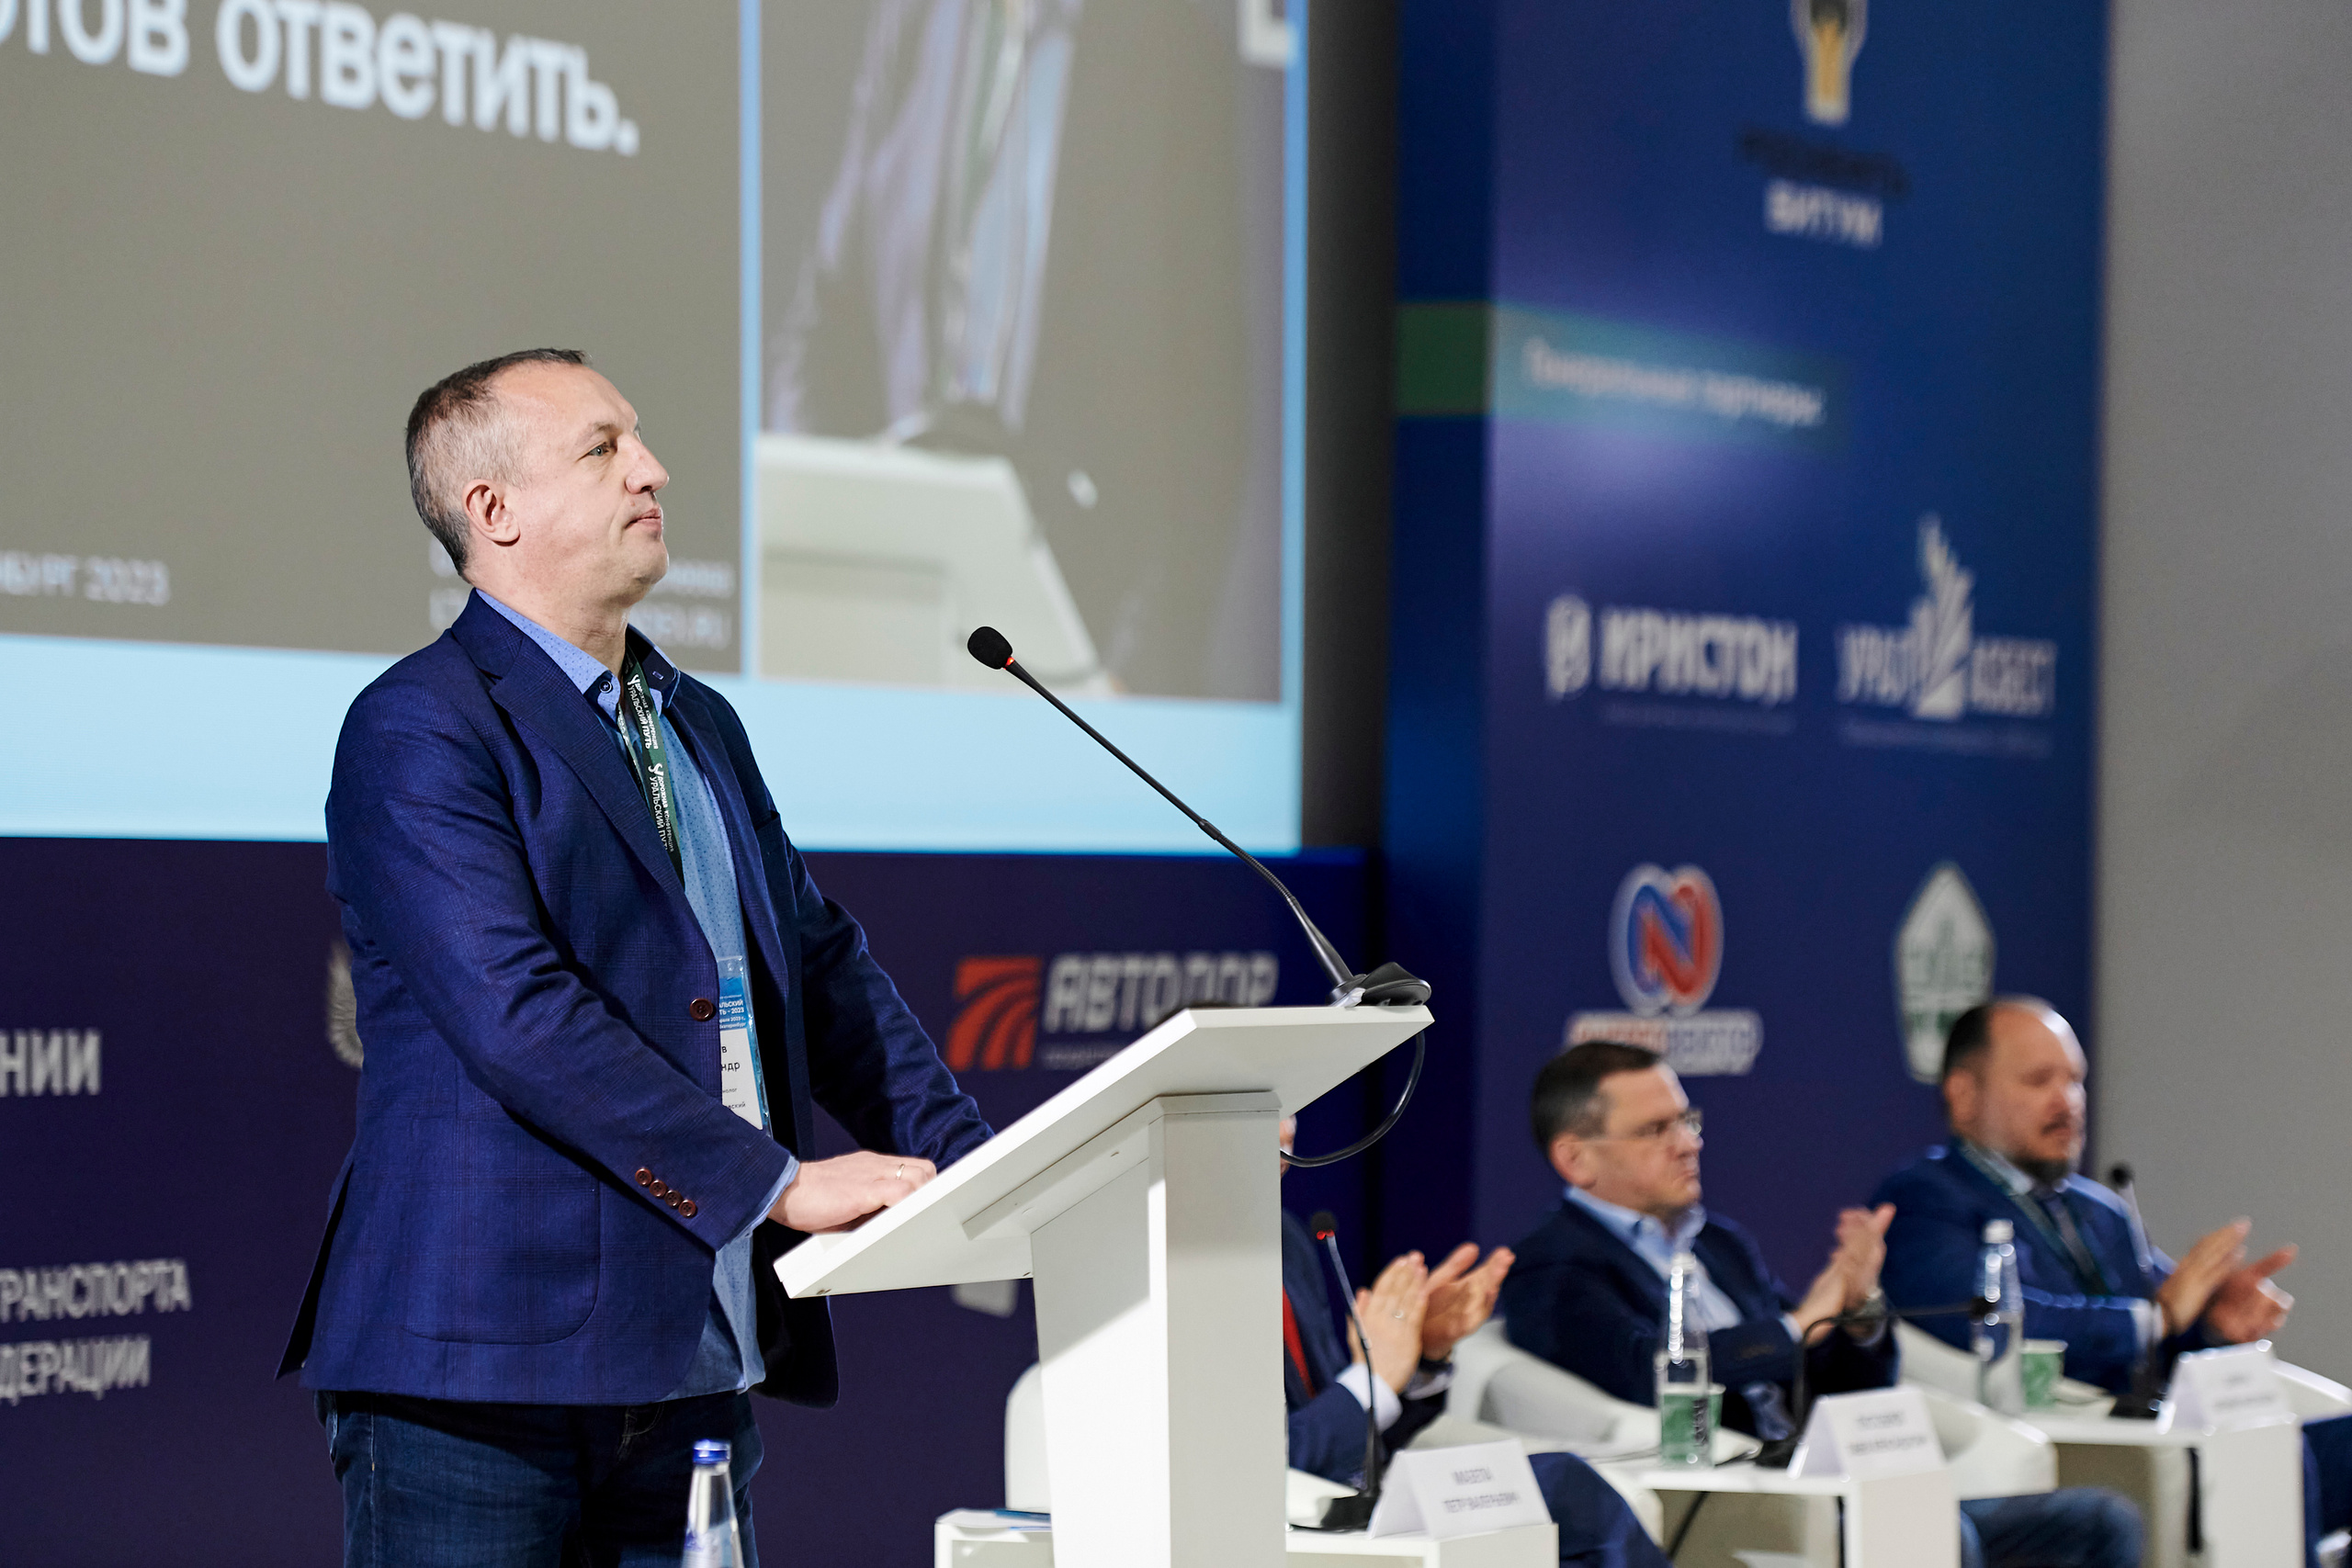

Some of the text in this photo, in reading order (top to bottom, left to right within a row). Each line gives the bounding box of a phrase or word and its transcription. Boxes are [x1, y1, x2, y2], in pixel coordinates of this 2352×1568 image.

[0, 0, 640, 155] тов ответить.
[628, 685, 649, 725] УРАЛЬСКИЙ
[642, 725, 652, 750] ПУТЬ
[650, 776, 668, 851] УРАЛЬСКИЙ ПУТ
[0, 1258, 192, 1323] РАНСПОРТА
